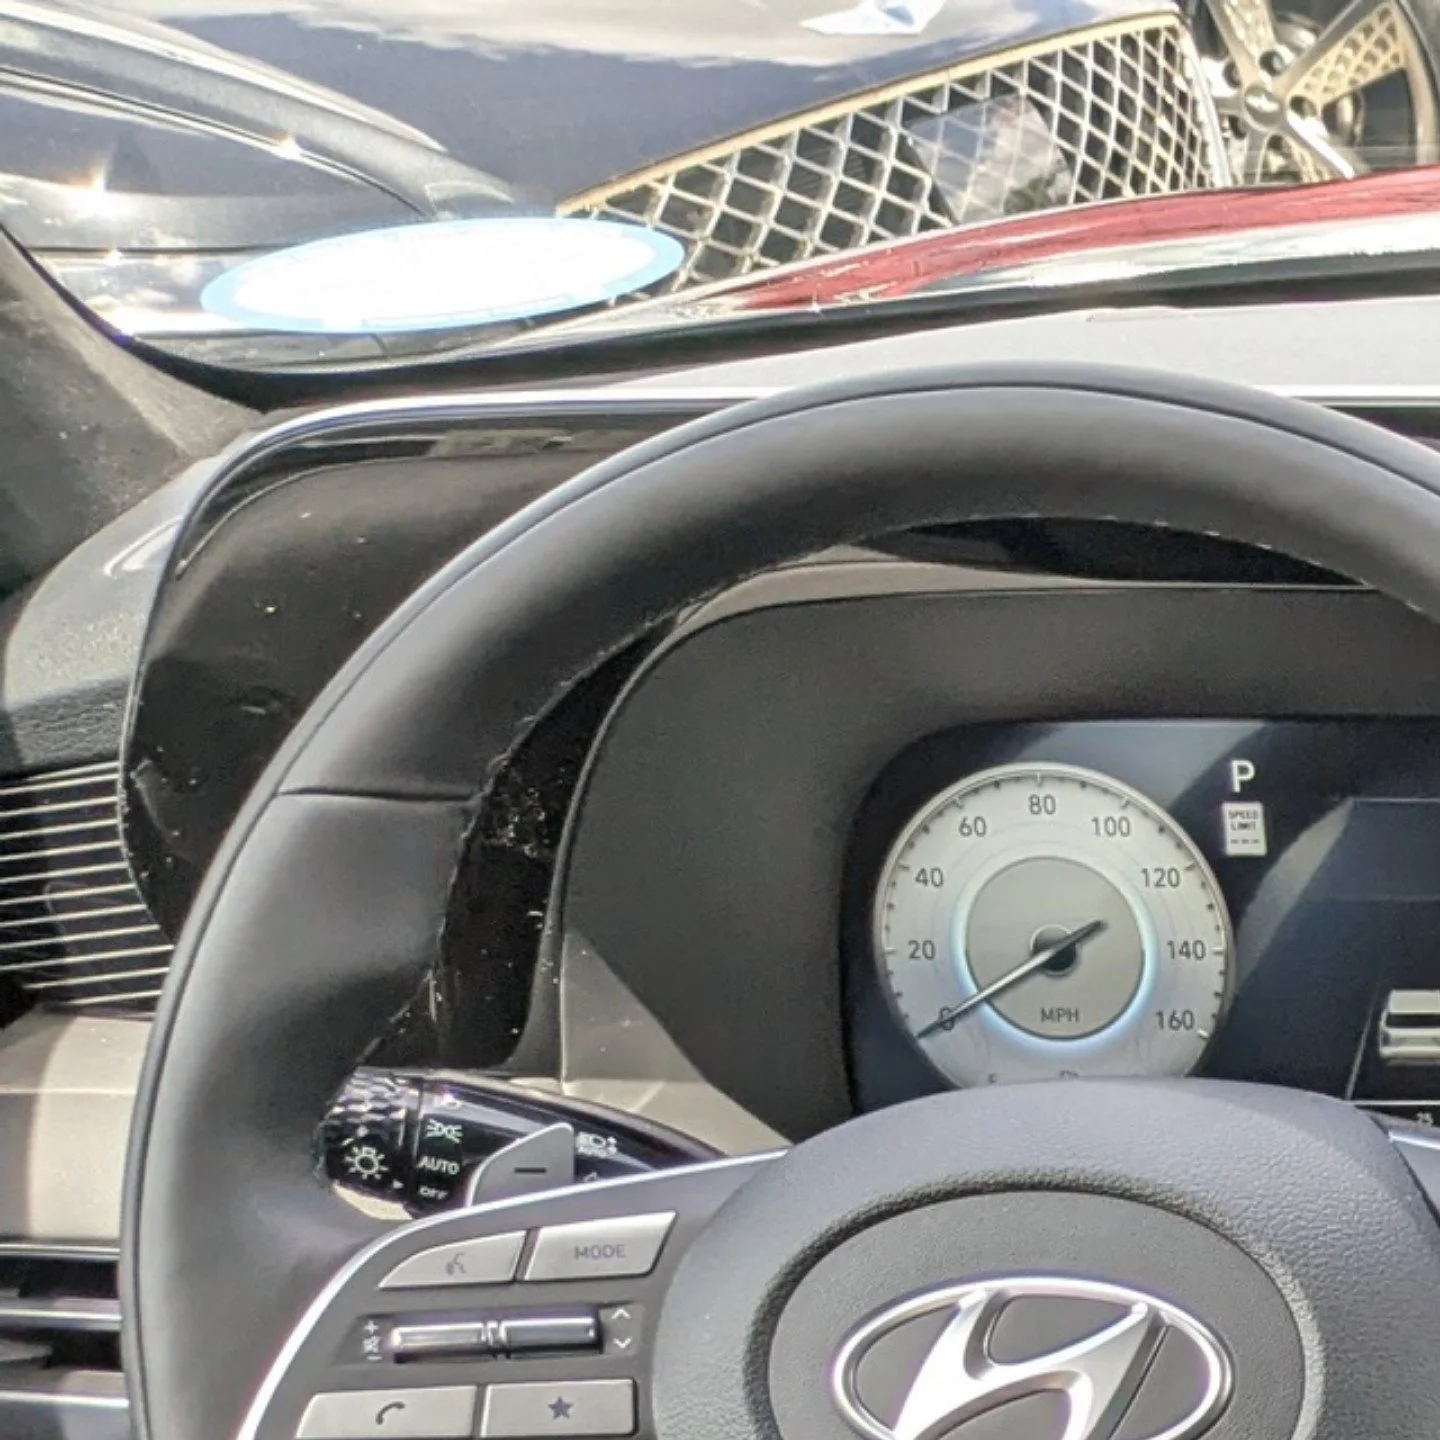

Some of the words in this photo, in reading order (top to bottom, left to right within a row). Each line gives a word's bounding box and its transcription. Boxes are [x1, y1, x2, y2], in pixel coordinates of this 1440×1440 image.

[1231, 759, 1256, 793] P
[1029, 794, 1056, 815] 80
[958, 817, 987, 838] 60
[1091, 817, 1131, 838] 100
[915, 868, 944, 888] 40
[1140, 868, 1181, 889] 120
[908, 940, 936, 961] 20
[1166, 940, 1206, 961] 140
[1040, 1007, 1080, 1024] MPH
[1155, 1010, 1195, 1031] 160
[1416, 1112, 1434, 1126] 25
[416, 1156, 460, 1175] AUTO
[420, 1186, 447, 1199] OFF
[574, 1243, 626, 1259] MODE
